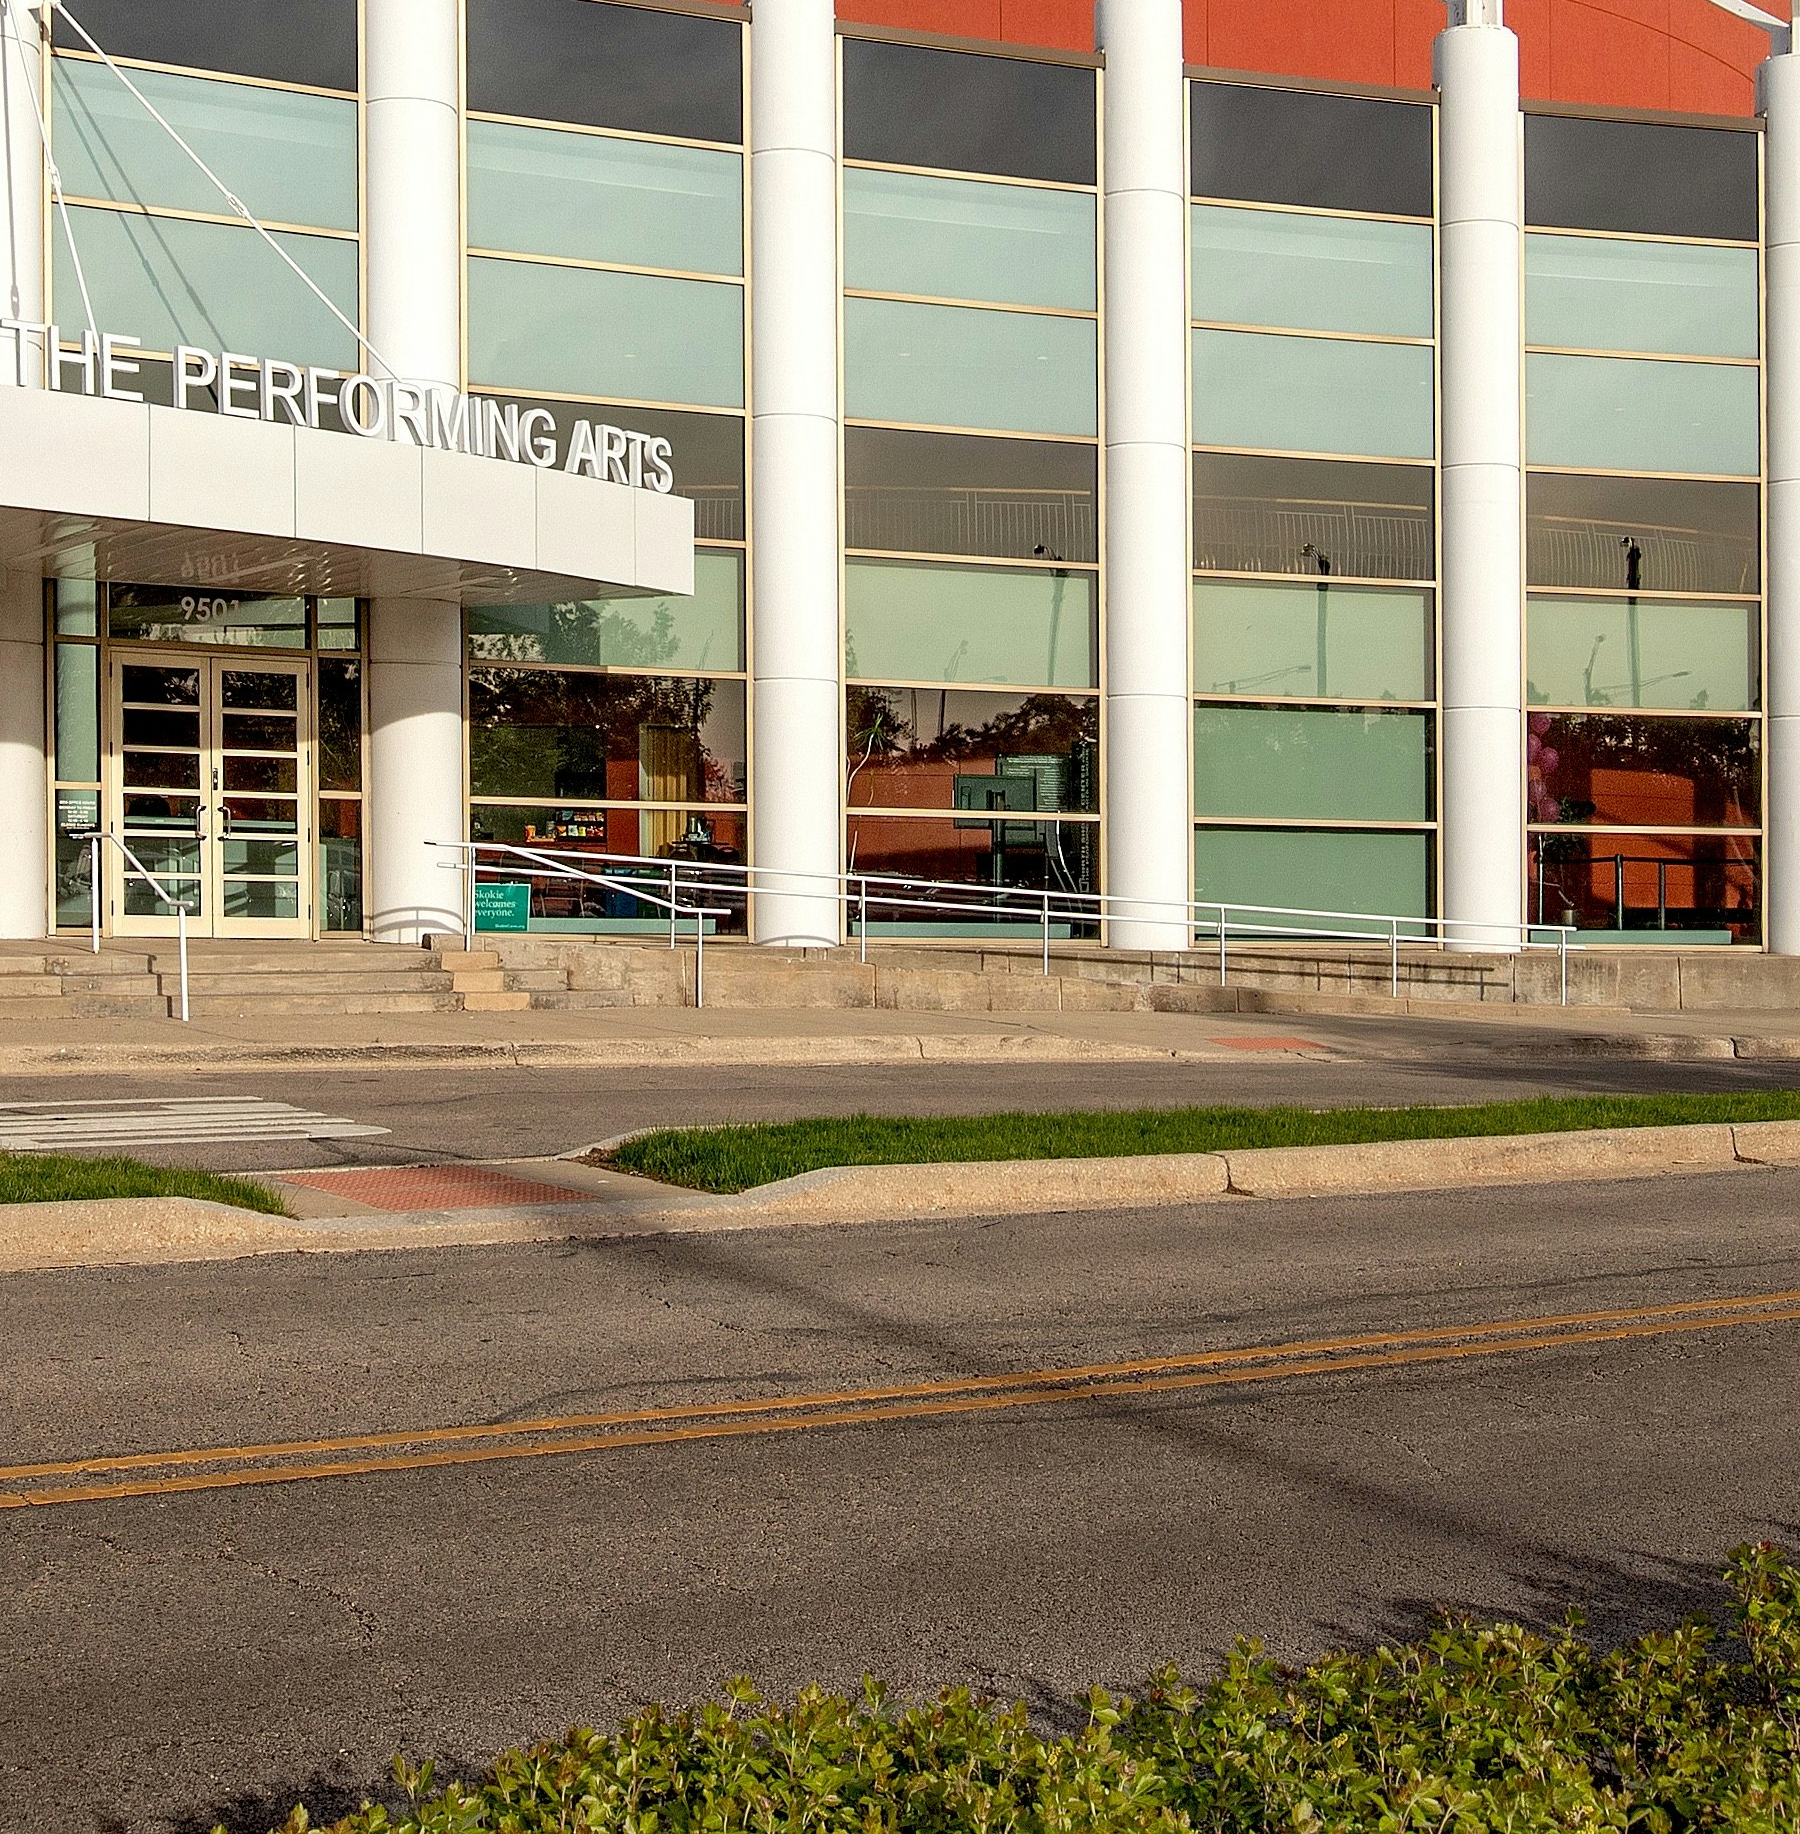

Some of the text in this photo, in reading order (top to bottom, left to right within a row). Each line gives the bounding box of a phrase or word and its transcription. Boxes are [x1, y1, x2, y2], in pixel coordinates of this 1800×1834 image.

[173, 344, 557, 468] PERFORMING
[564, 419, 674, 495] ARTS
[475, 889, 504, 899] Skokie
